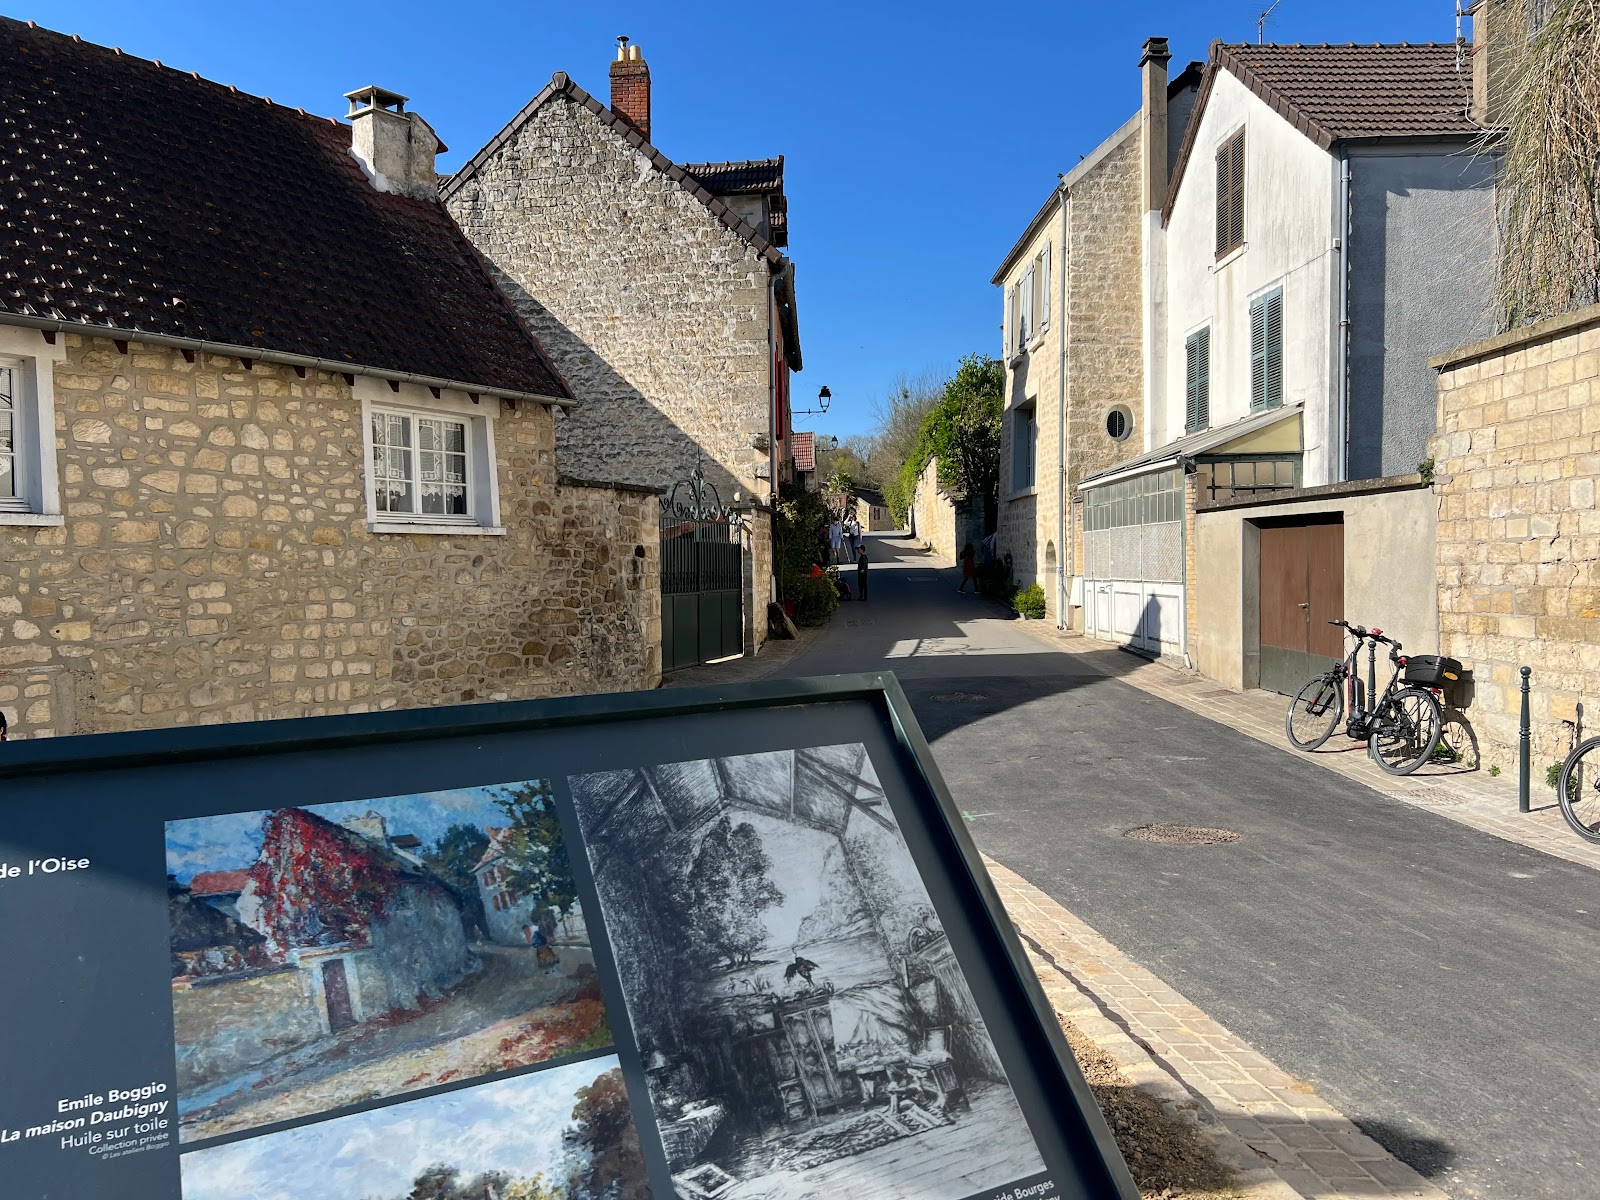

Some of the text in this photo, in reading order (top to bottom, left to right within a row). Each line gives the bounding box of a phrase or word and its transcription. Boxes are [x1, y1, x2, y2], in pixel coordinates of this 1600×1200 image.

[57, 1081, 167, 1113] Emile Boggio
[0, 1099, 169, 1143] La maison Daubigny
[61, 1116, 168, 1150] Huile sur toile
[88, 1131, 169, 1155] Collection privée
[1014, 1180, 1054, 1199] Bourges
